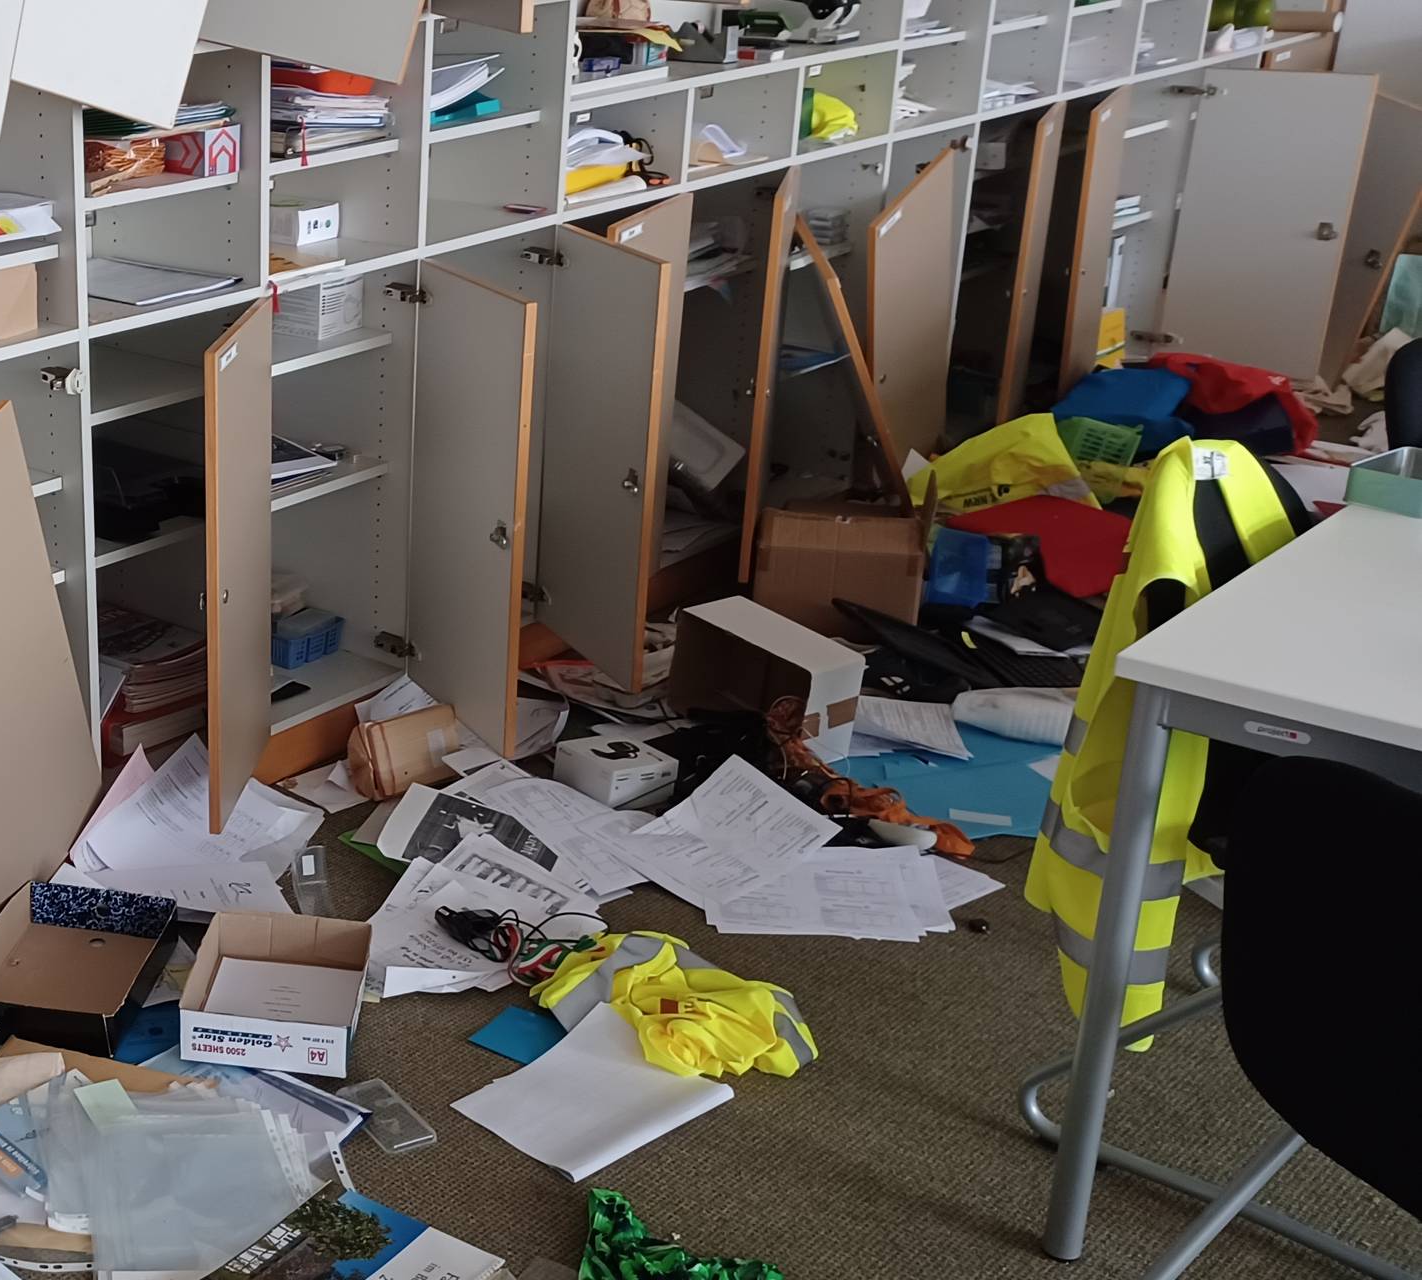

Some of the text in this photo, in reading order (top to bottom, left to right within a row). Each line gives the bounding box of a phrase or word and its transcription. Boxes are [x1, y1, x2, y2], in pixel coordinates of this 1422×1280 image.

[228, 1035, 273, 1048] Golden
[191, 1043, 246, 1057] 2500 SHEETS
[309, 1050, 326, 1063] A4
